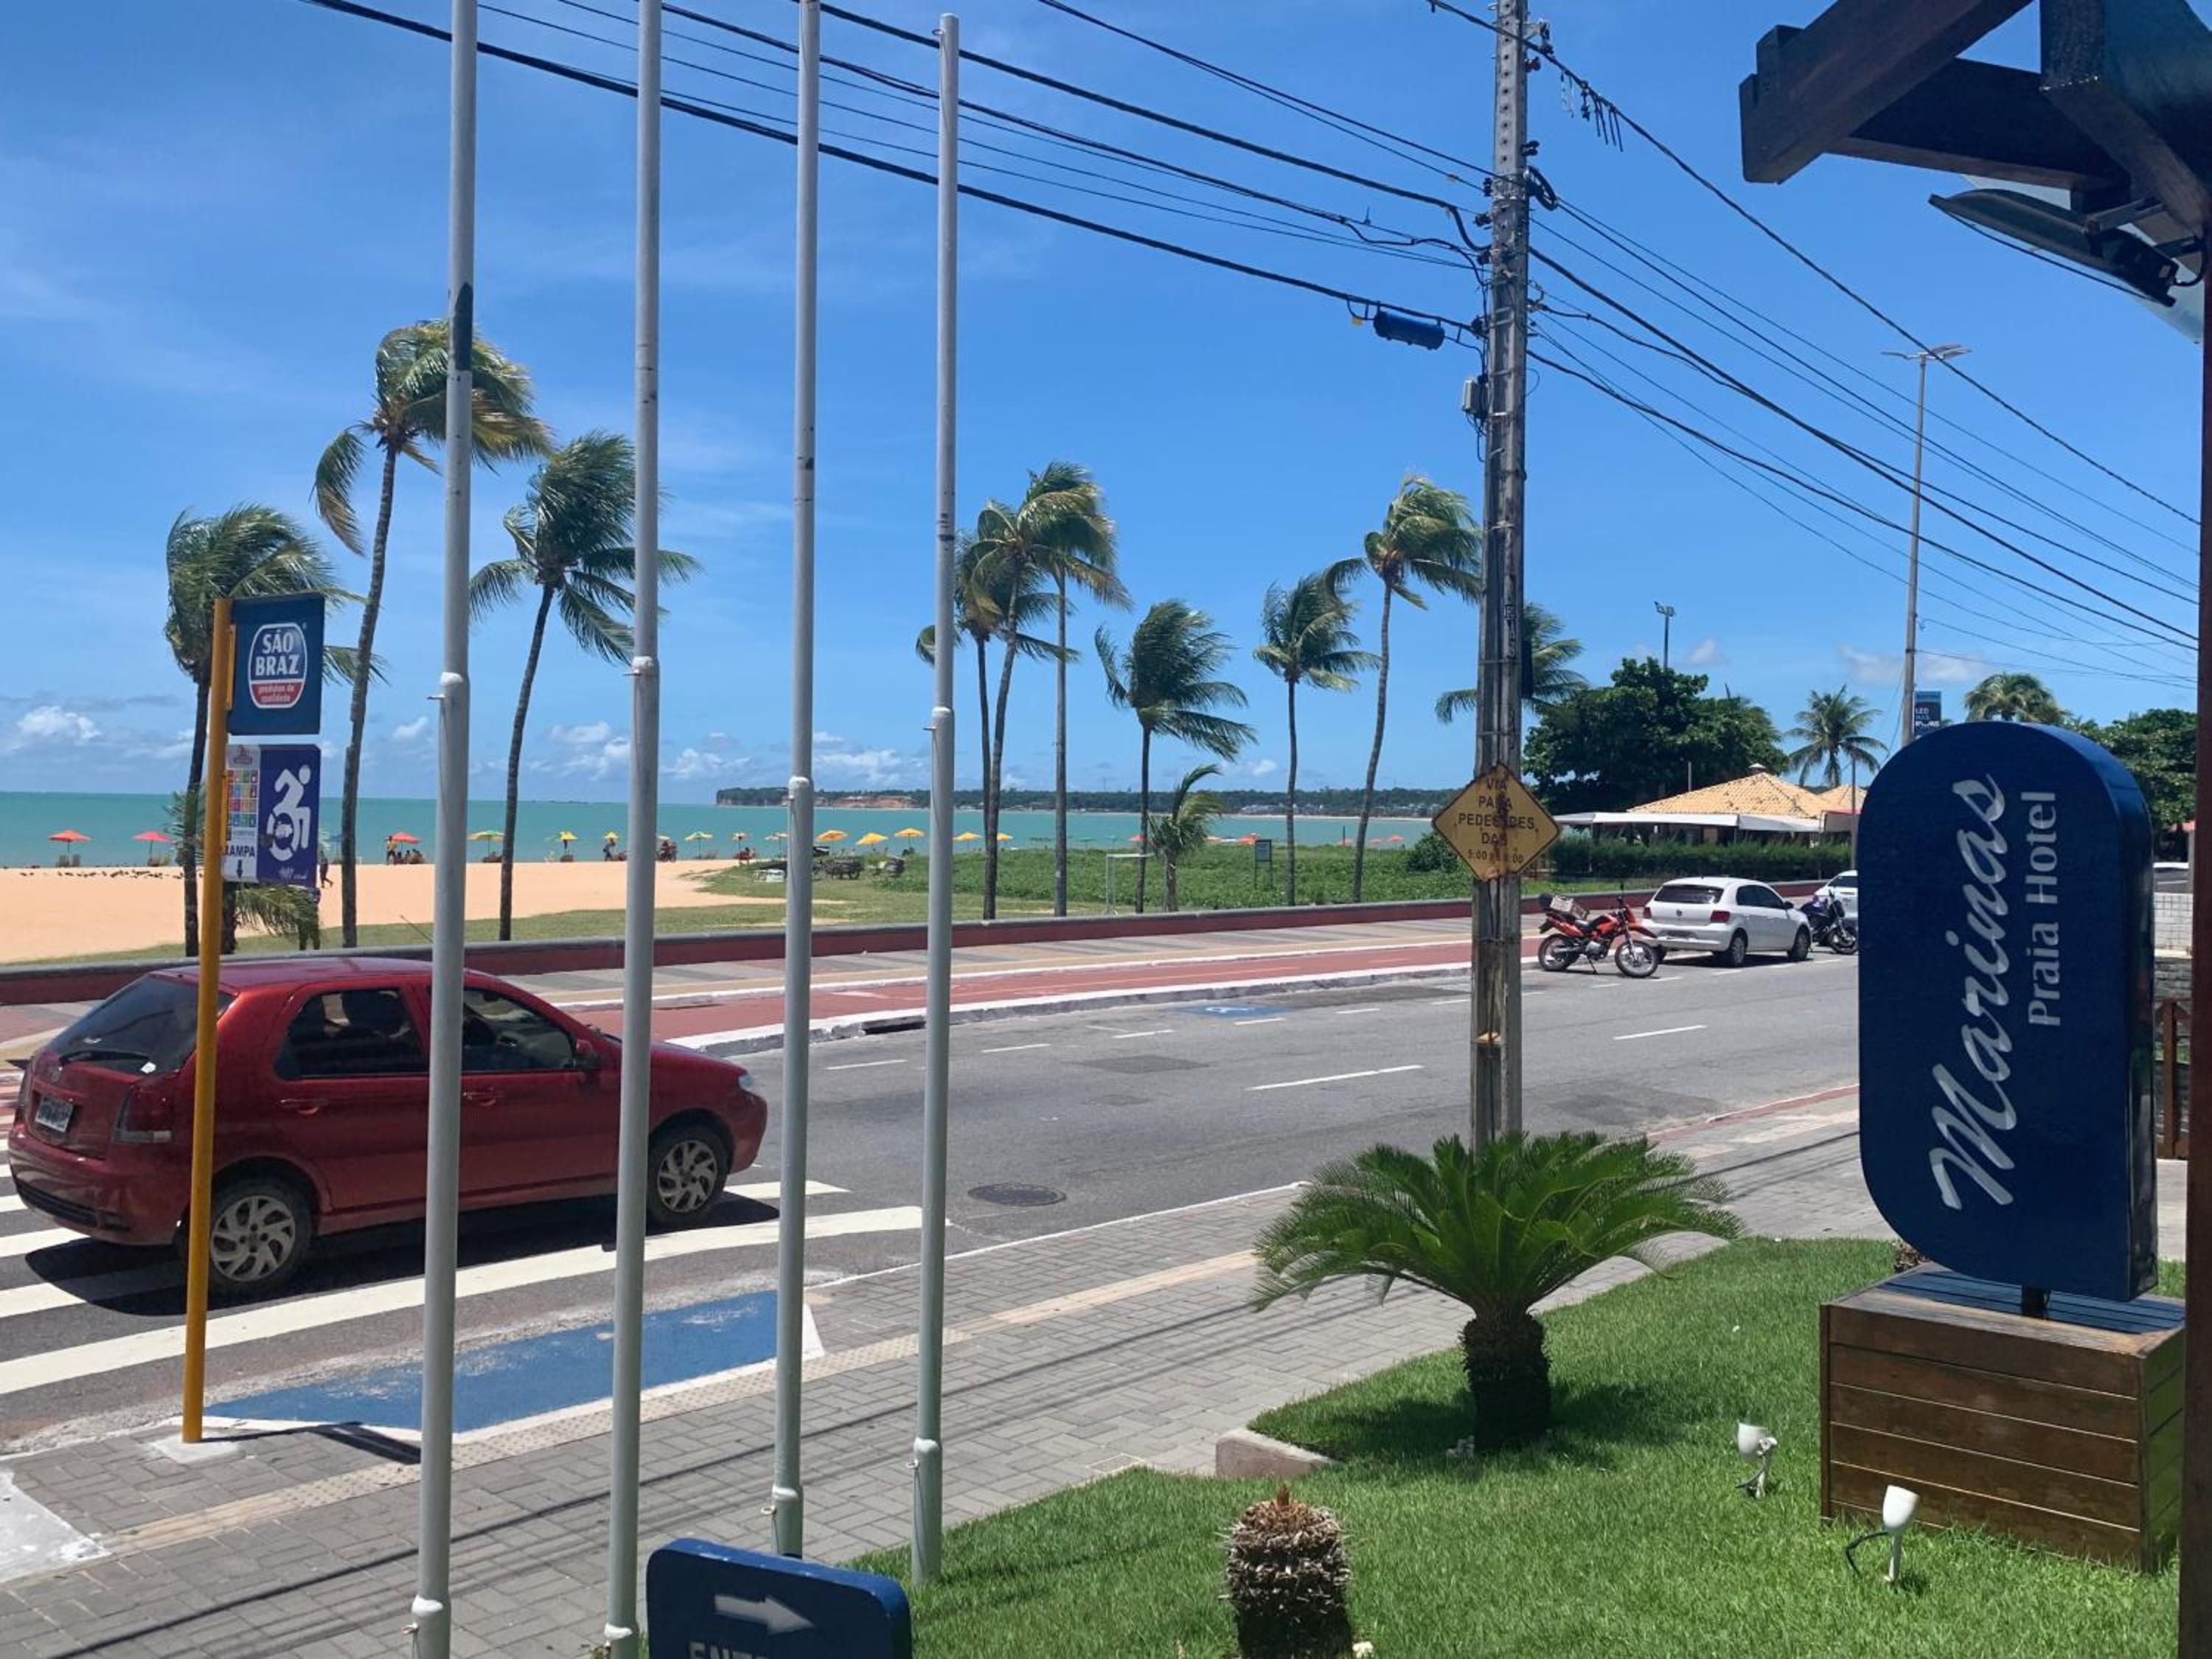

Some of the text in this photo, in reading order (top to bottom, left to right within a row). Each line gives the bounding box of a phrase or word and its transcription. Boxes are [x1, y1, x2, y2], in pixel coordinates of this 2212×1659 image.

[255, 655, 299, 675] BRAZ
[1486, 779, 1507, 791] VIA
[1478, 796, 1512, 810] PAA
[1458, 813, 1534, 830] PEDESRES
[1482, 833, 1507, 846] DAS
[2020, 791, 2061, 1026] Praia Hotel
[1927, 772, 2017, 1211] Marinas
